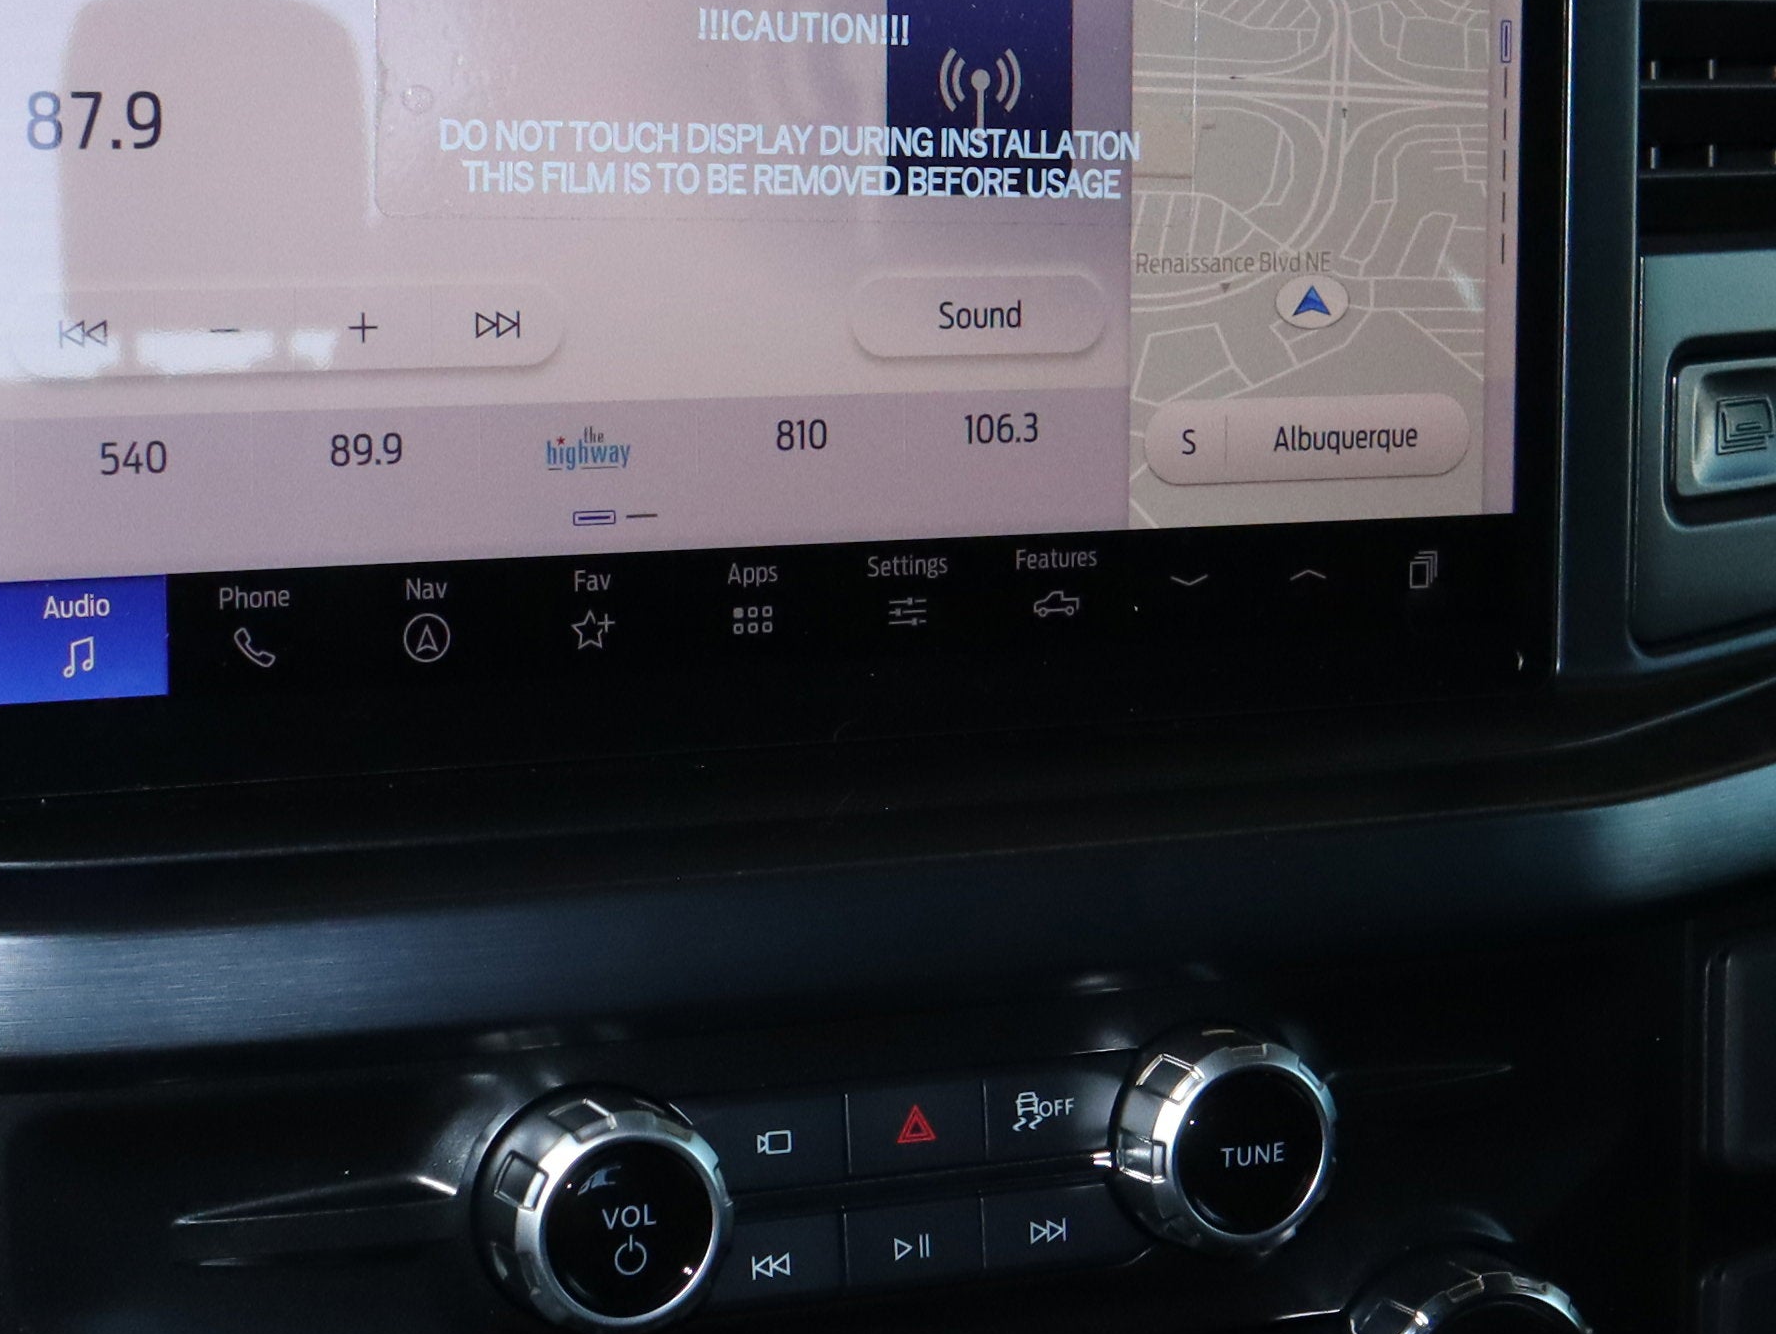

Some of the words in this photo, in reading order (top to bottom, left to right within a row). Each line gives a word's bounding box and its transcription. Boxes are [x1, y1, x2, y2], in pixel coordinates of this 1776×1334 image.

[26, 90, 163, 150] 87.9
[440, 117, 487, 152] DO
[495, 119, 563, 152] NOT
[568, 120, 678, 154] TOUCH
[687, 122, 812, 155] DISPLAY
[820, 125, 933, 158] DURING
[941, 127, 1139, 160] INSTALLATION
[462, 159, 535, 194] THIS
[542, 160, 615, 194] FILM
[625, 162, 651, 195] IS
[656, 162, 700, 195] TO
[707, 163, 747, 195] BE
[754, 163, 901, 197] REMOVED
[908, 166, 1021, 198] BEFORE
[1027, 168, 1121, 199] USAGE
[1136, 252, 1255, 274] Renaissance
[1259, 251, 1301, 272] Blvd
[1305, 250, 1332, 272] NE
[938, 299, 1023, 330] Sound
[584, 426, 604, 443] the
[776, 419, 828, 452] 810
[963, 413, 1039, 444] 106.3
[1273, 421, 1418, 456] Albuquerque
[330, 434, 403, 466] 89.9
[546, 439, 631, 470] highway
[1181, 430, 1196, 455] S
[99, 441, 167, 475] 540
[867, 553, 948, 579] Settings
[1015, 547, 1098, 572] Features
[574, 569, 610, 593] Fav
[728, 561, 777, 587] Apps
[219, 584, 290, 609] Phone
[405, 577, 448, 601] Nav
[43, 594, 110, 620] Audio
[1039, 1097, 1074, 1118] OFF
[1221, 1142, 1284, 1167] TUNE
[602, 1204, 656, 1229] VOL
